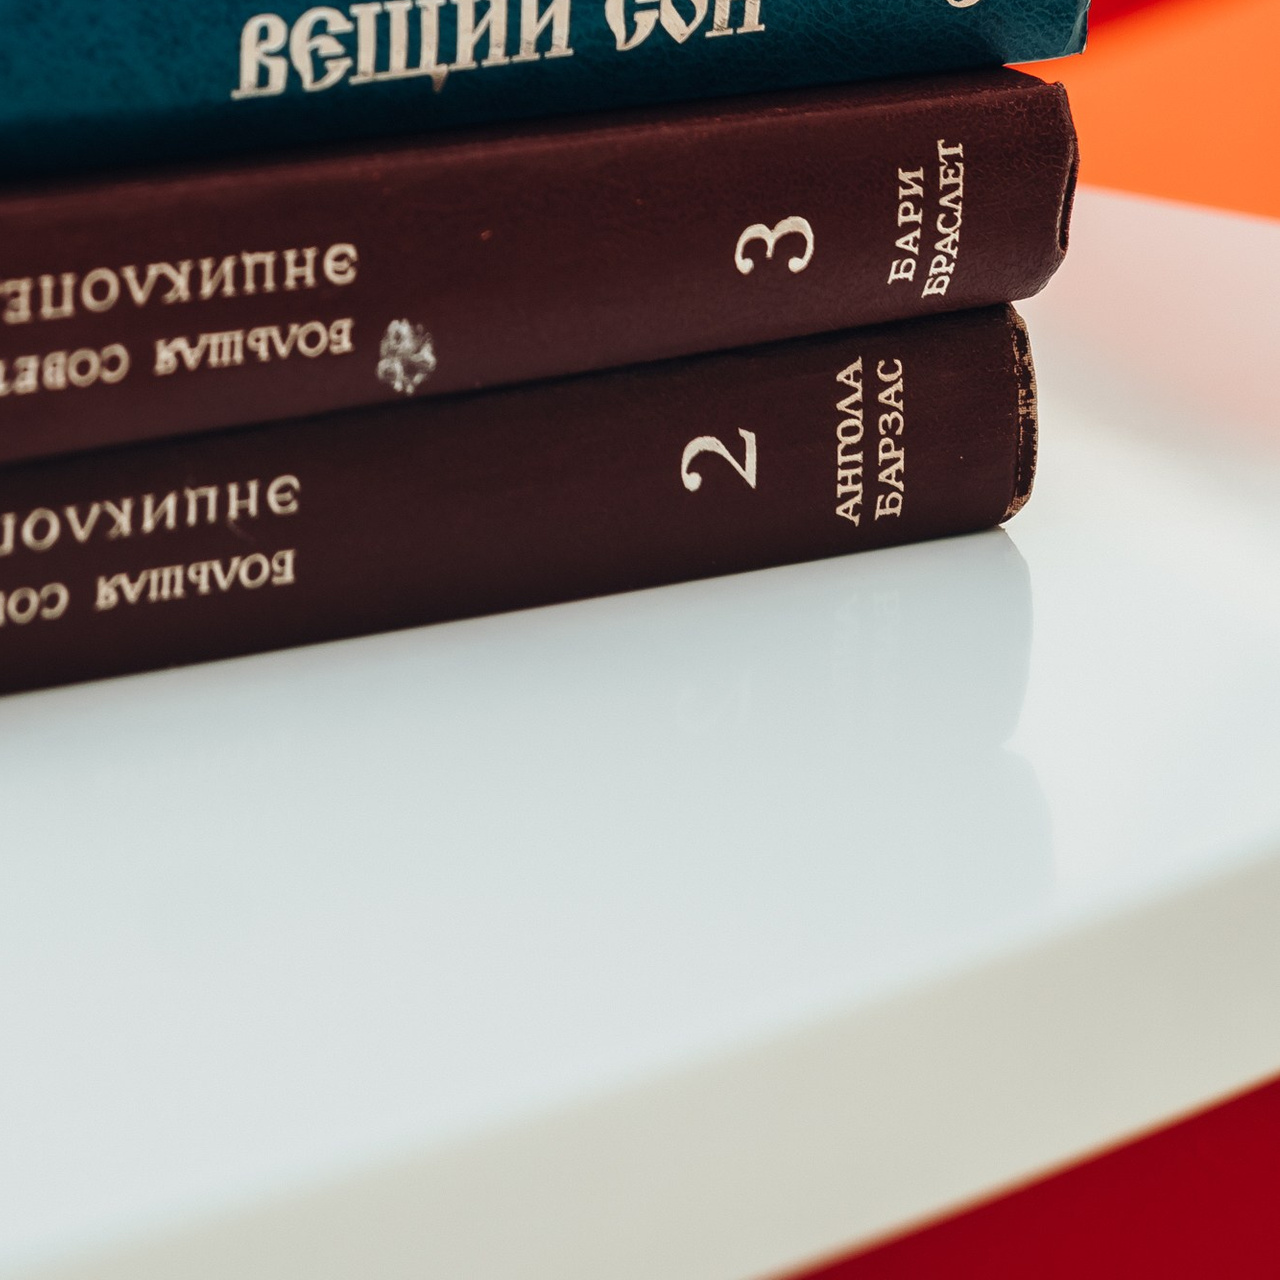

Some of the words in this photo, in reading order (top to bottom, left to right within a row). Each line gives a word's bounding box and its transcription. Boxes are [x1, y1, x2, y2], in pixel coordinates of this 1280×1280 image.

[734, 216, 815, 275] 3
[887, 166, 925, 285] БАРИ
[921, 139, 964, 298] БРАСЛЕТ
[153, 317, 355, 376] БОЛЬШАЯ
[680, 427, 757, 492] 2
[836, 356, 864, 527] АНГОЛА
[874, 357, 905, 521] БАРЗАС
[95, 548, 297, 611] БОЛЬШАЯ
